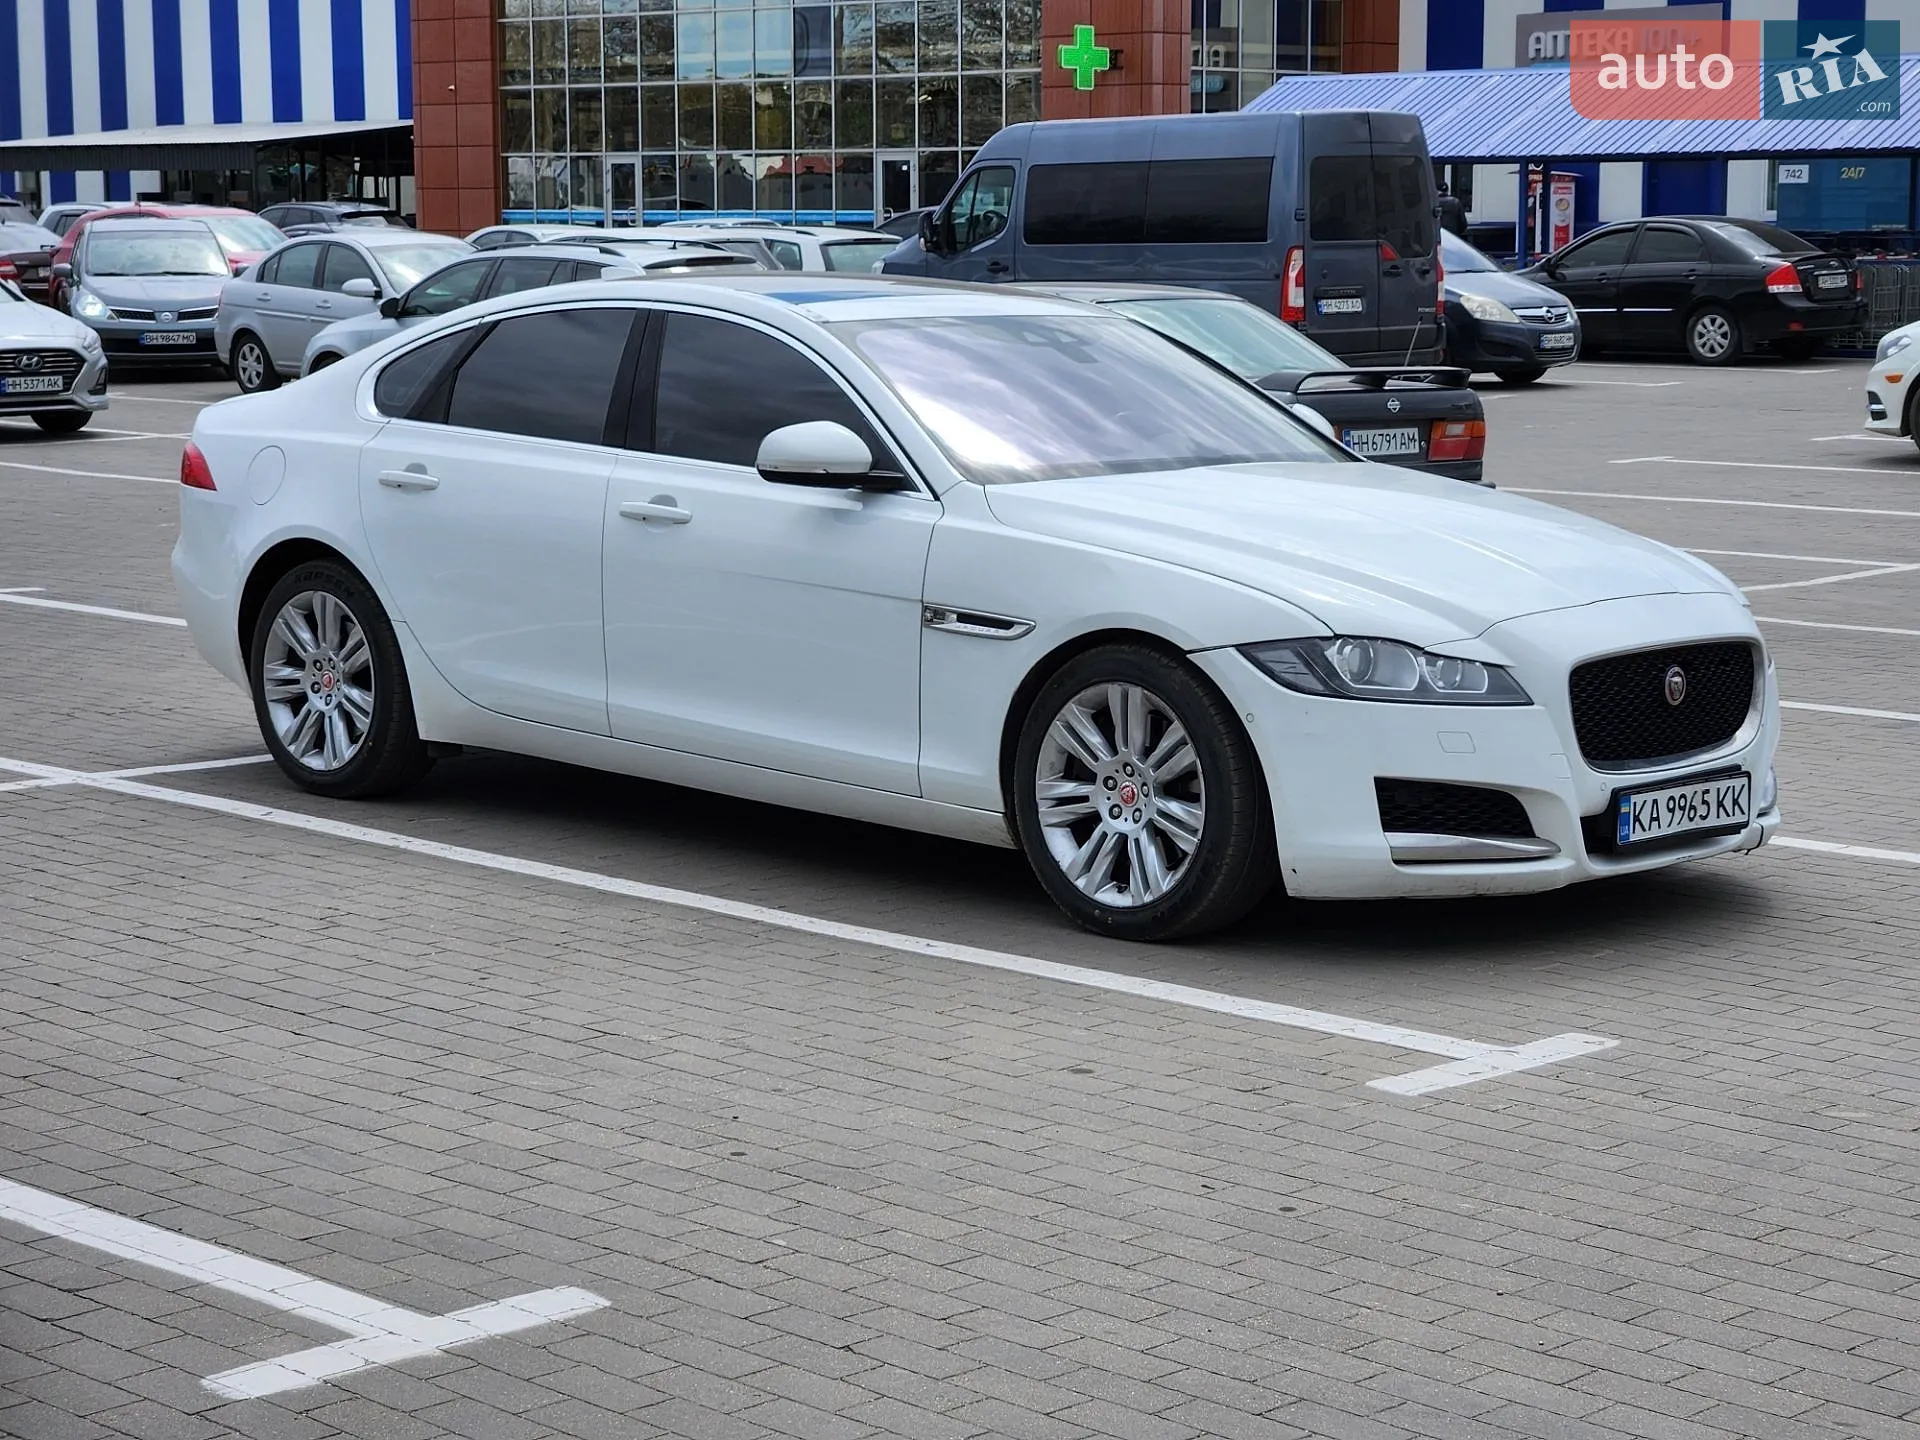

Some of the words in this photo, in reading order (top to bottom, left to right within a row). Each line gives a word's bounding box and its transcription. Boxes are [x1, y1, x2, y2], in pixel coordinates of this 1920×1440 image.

[1528, 27, 1634, 59] АПТЕКА
[1784, 169, 1803, 179] 742
[1841, 167, 1865, 179] 24/7
[7, 379, 21, 390] HH
[24, 379, 45, 389] 5371
[47, 378, 60, 388] AK
[1352, 433, 1370, 452] HH
[1372, 432, 1398, 451] 6791
[1400, 431, 1418, 450] AM
[1632, 798, 1661, 834] KA
[1666, 789, 1710, 828] 9965
[1716, 784, 1746, 819] KK
